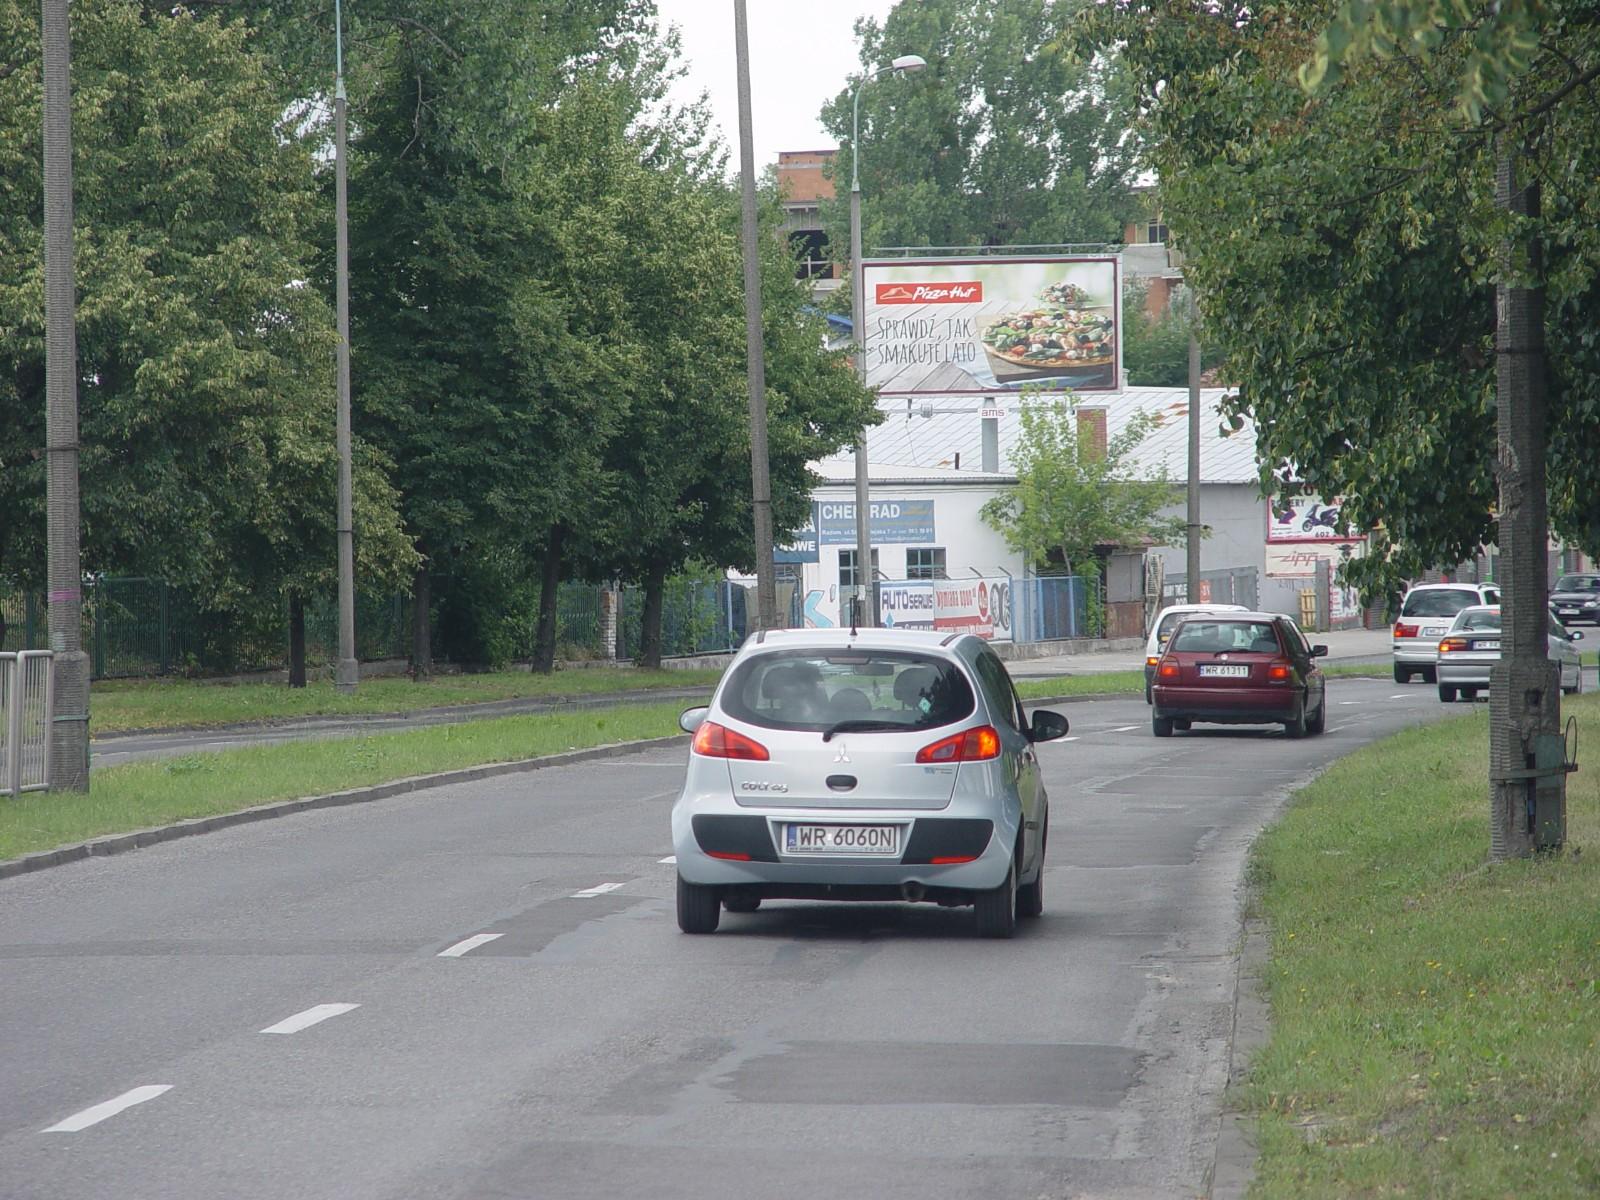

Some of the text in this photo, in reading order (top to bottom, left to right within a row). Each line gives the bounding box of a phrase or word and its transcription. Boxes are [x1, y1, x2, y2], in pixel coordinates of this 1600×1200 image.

[912, 285, 977, 300] Pizza Hut
[945, 318, 973, 340] JAK
[878, 342, 976, 365] SMAKUJE LATO
[981, 409, 1005, 417] ams
[1205, 666, 1246, 675] WR 61311
[799, 827, 892, 847] WR 6060N
